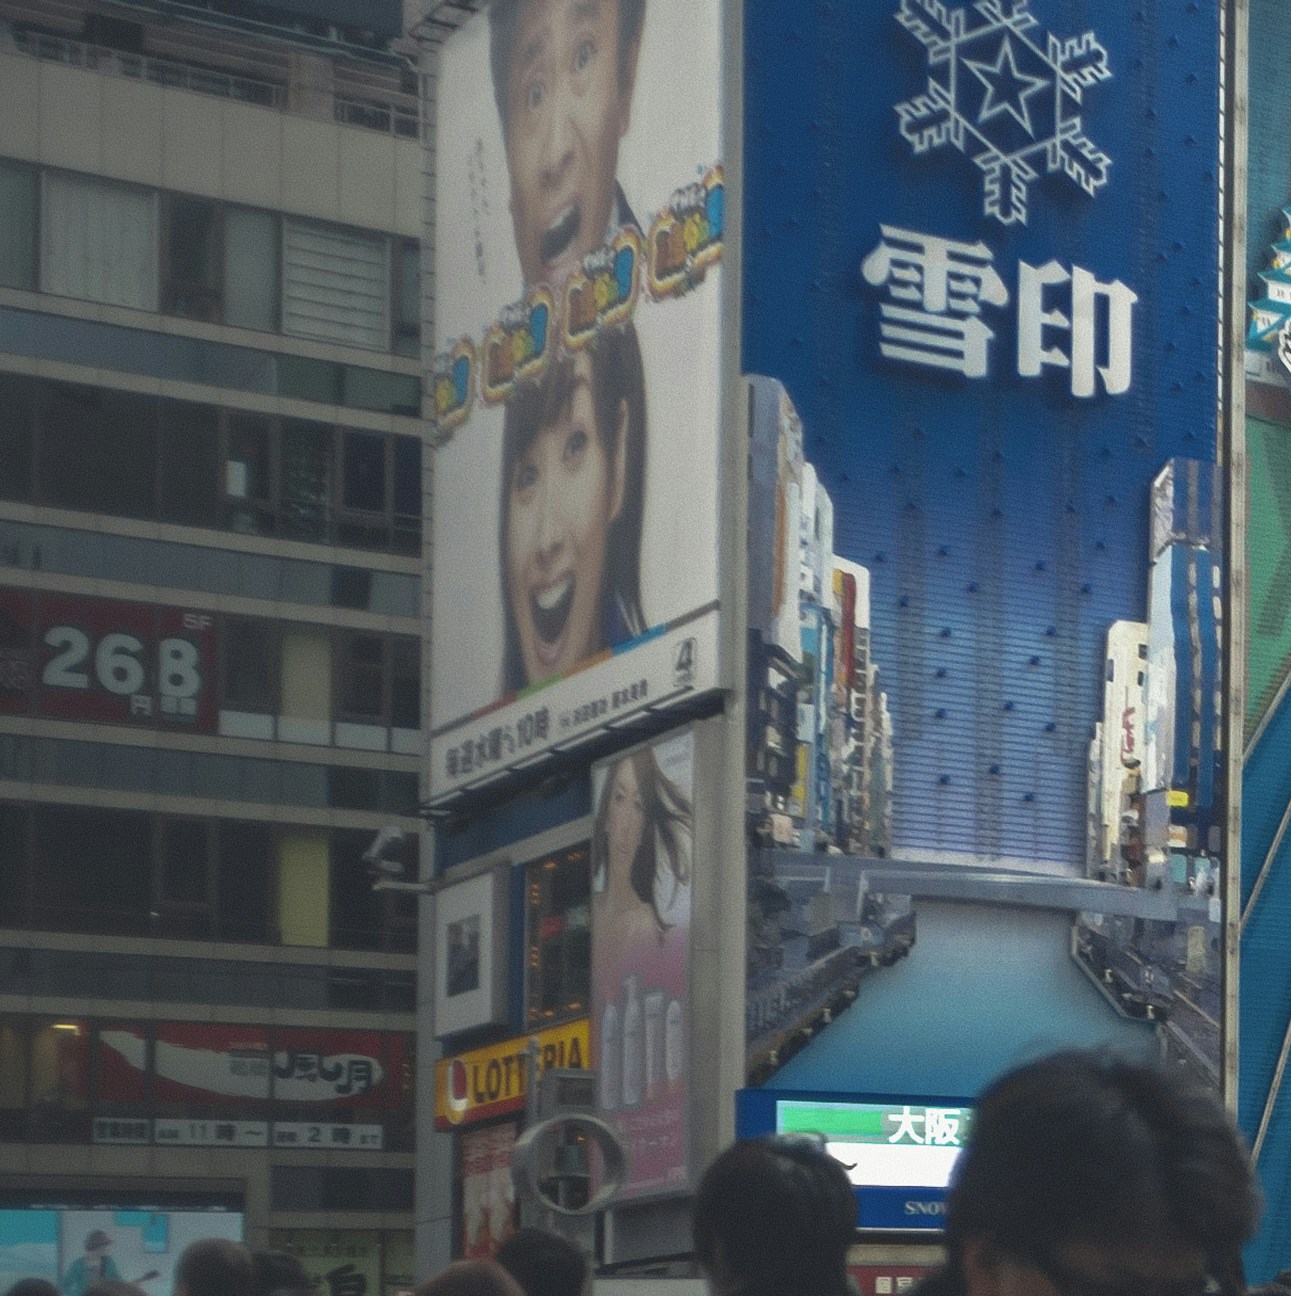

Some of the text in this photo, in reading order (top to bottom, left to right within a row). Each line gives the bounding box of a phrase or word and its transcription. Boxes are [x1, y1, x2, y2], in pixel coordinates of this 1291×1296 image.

[861, 223, 1138, 398] 雪印
[41, 624, 202, 699] 268
[472, 1035, 583, 1104] LOTTRIA
